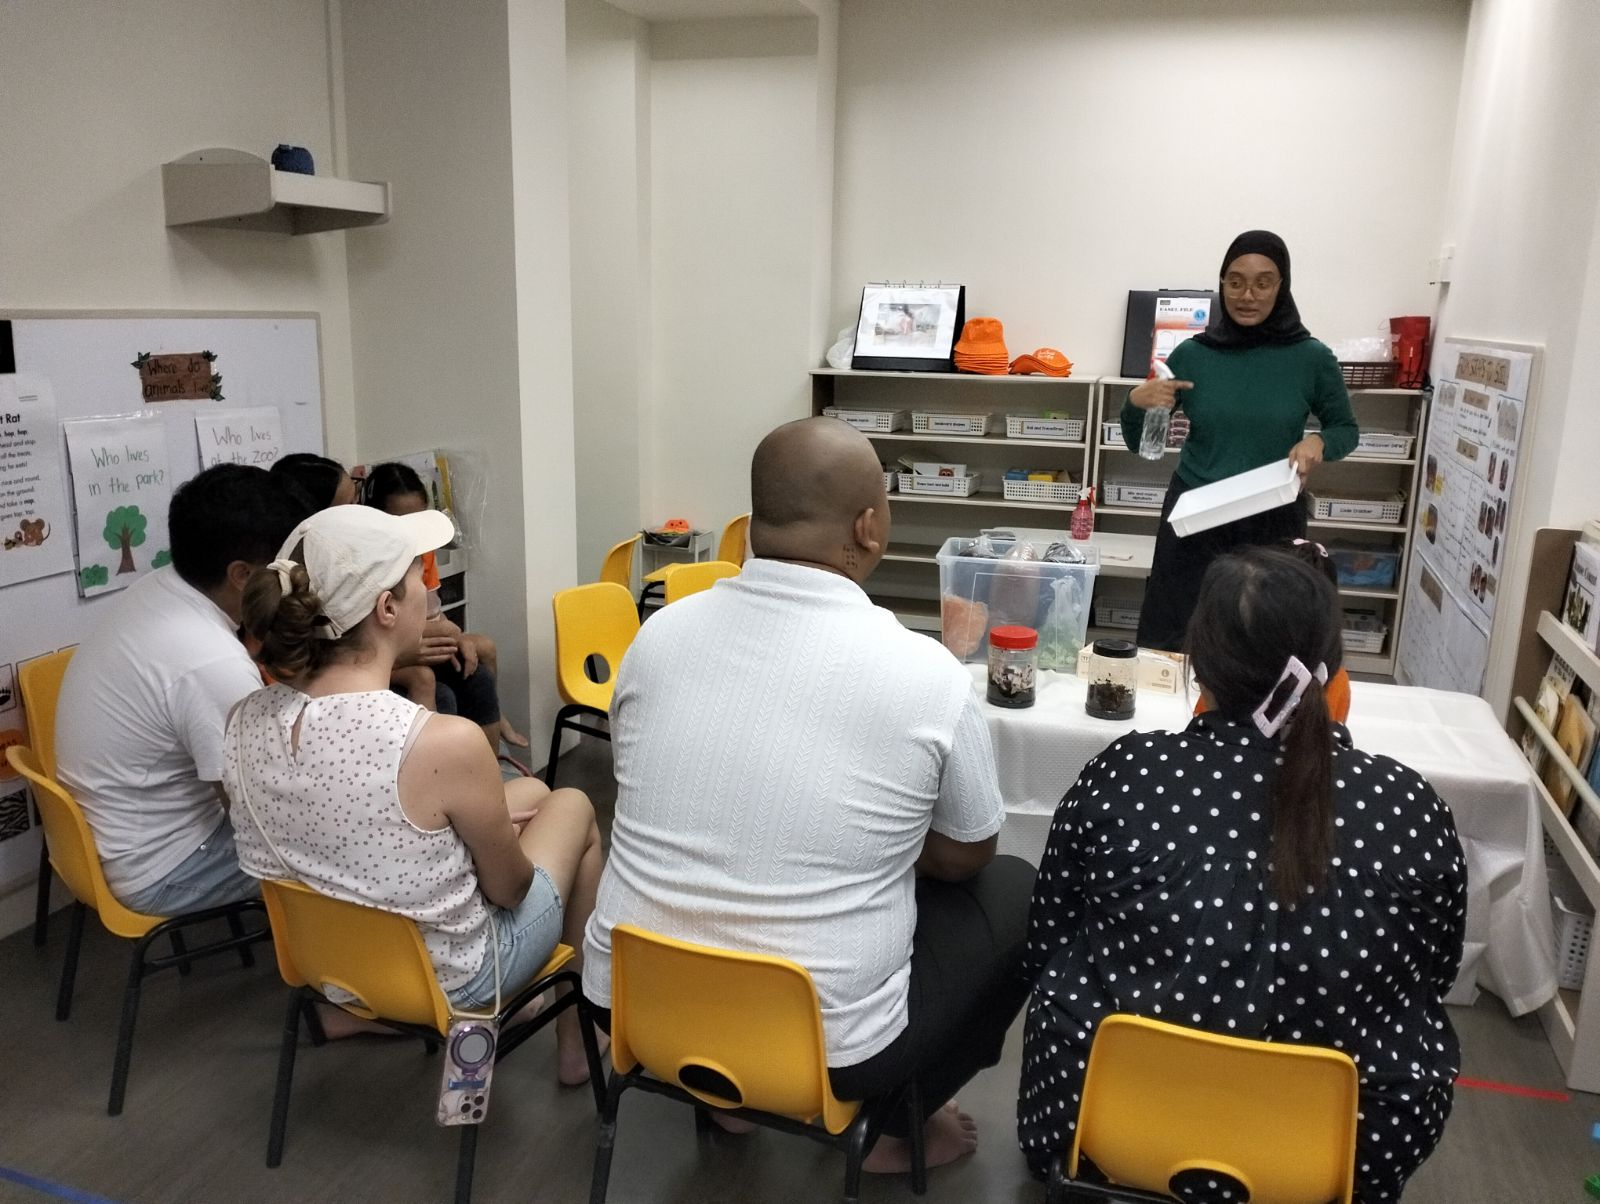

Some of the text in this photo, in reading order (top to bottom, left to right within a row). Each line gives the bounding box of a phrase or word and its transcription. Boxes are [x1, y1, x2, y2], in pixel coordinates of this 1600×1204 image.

[147, 358, 201, 376] Where do
[144, 379, 186, 398] animals
[6, 413, 20, 424] Rat
[212, 425, 272, 446] Who lives
[91, 445, 150, 468] Who lives
[231, 451, 248, 465] the
[88, 469, 164, 496] in the park?
